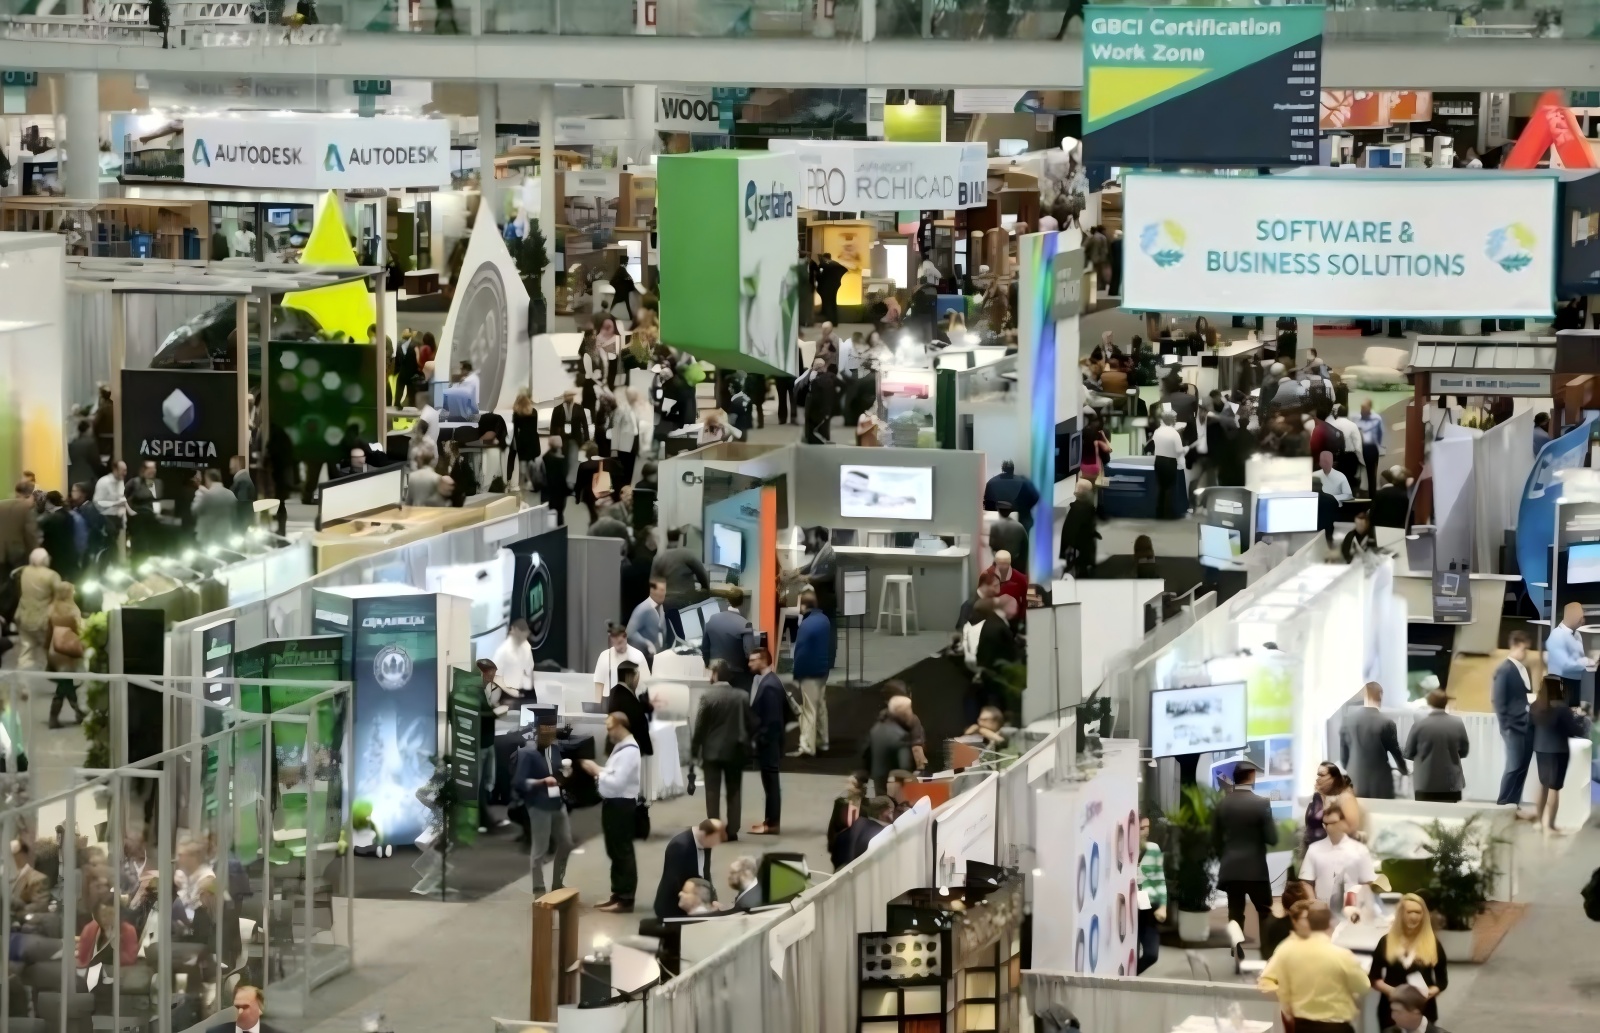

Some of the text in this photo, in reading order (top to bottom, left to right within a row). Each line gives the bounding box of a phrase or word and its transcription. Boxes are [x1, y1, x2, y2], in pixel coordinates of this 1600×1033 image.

[1091, 17, 1281, 36] GBCI Certification
[1091, 43, 1205, 62] Work Zone
[661, 98, 720, 121] WOOD
[215, 144, 303, 166] AUTODESK
[348, 145, 439, 166] AUTODESK
[1255, 219, 1415, 243] SOFTWARE &
[1206, 250, 1466, 277] BUSINESS SOLUTIONS
[140, 439, 217, 457] ASPECTA
